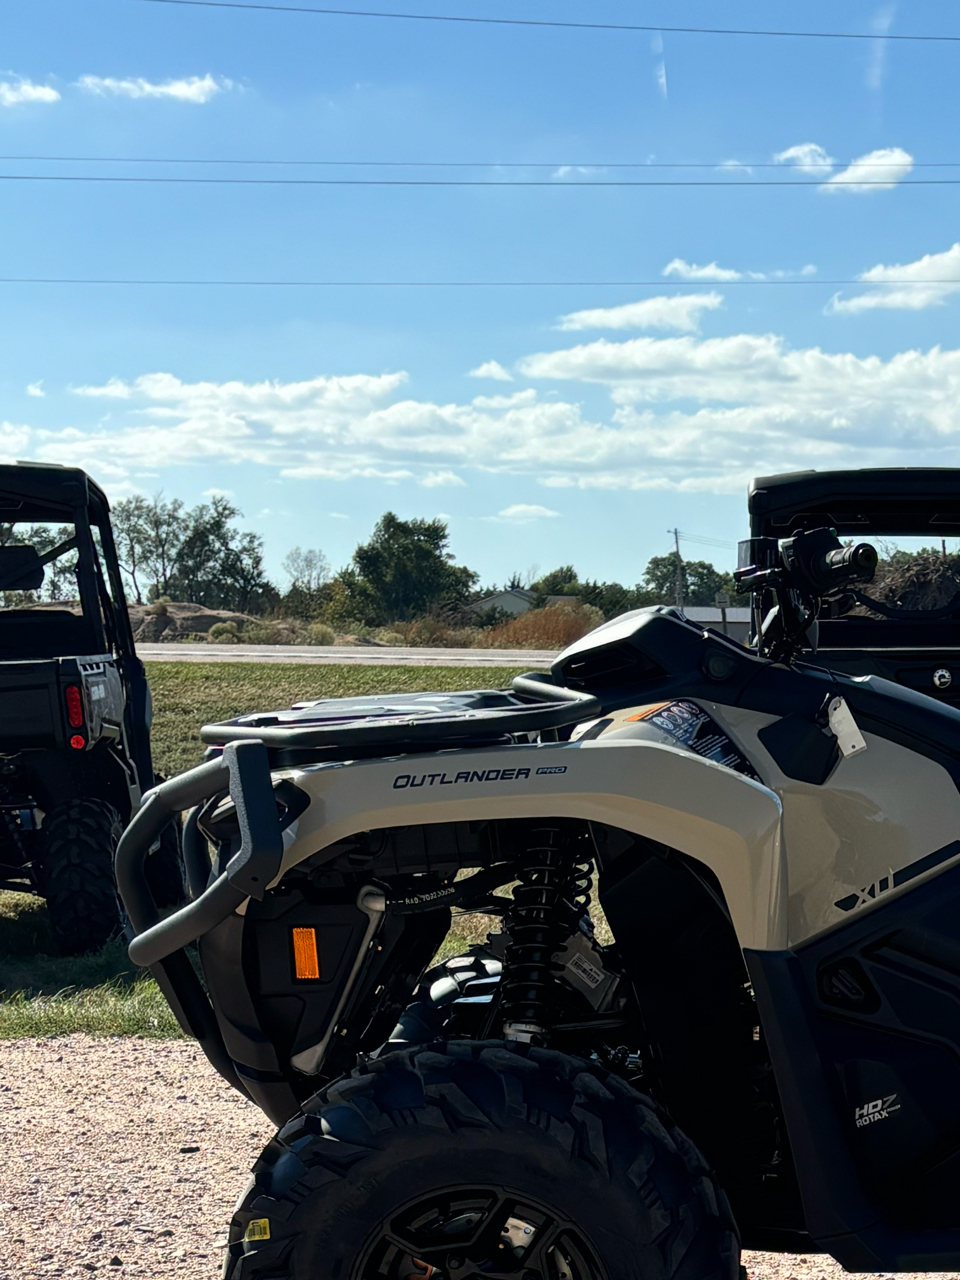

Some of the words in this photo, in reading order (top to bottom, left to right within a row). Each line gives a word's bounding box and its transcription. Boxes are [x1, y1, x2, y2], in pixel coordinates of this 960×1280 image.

[393, 768, 531, 789] OUTLANDER
[537, 766, 567, 774] PRO
[855, 1093, 897, 1120] HD7
[856, 1110, 889, 1128] ROTAX
